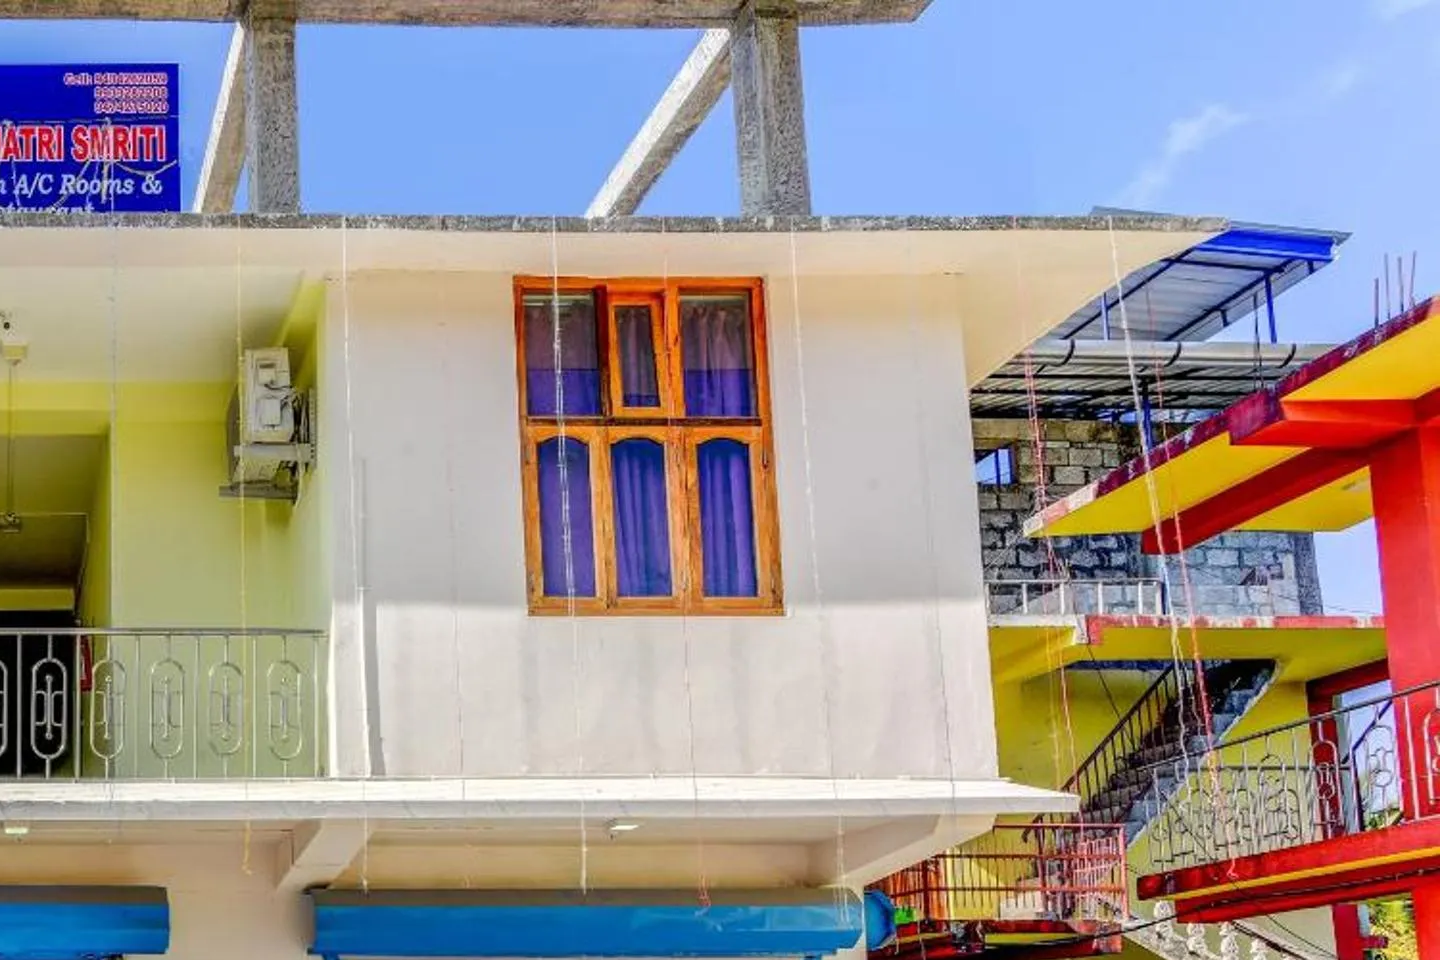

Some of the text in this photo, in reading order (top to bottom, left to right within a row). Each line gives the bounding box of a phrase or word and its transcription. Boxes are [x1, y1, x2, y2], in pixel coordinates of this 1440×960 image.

[71, 124, 166, 162] SMRITI
[13, 173, 54, 199] A/C
[59, 174, 135, 195] Rooms
[141, 174, 163, 195] &
